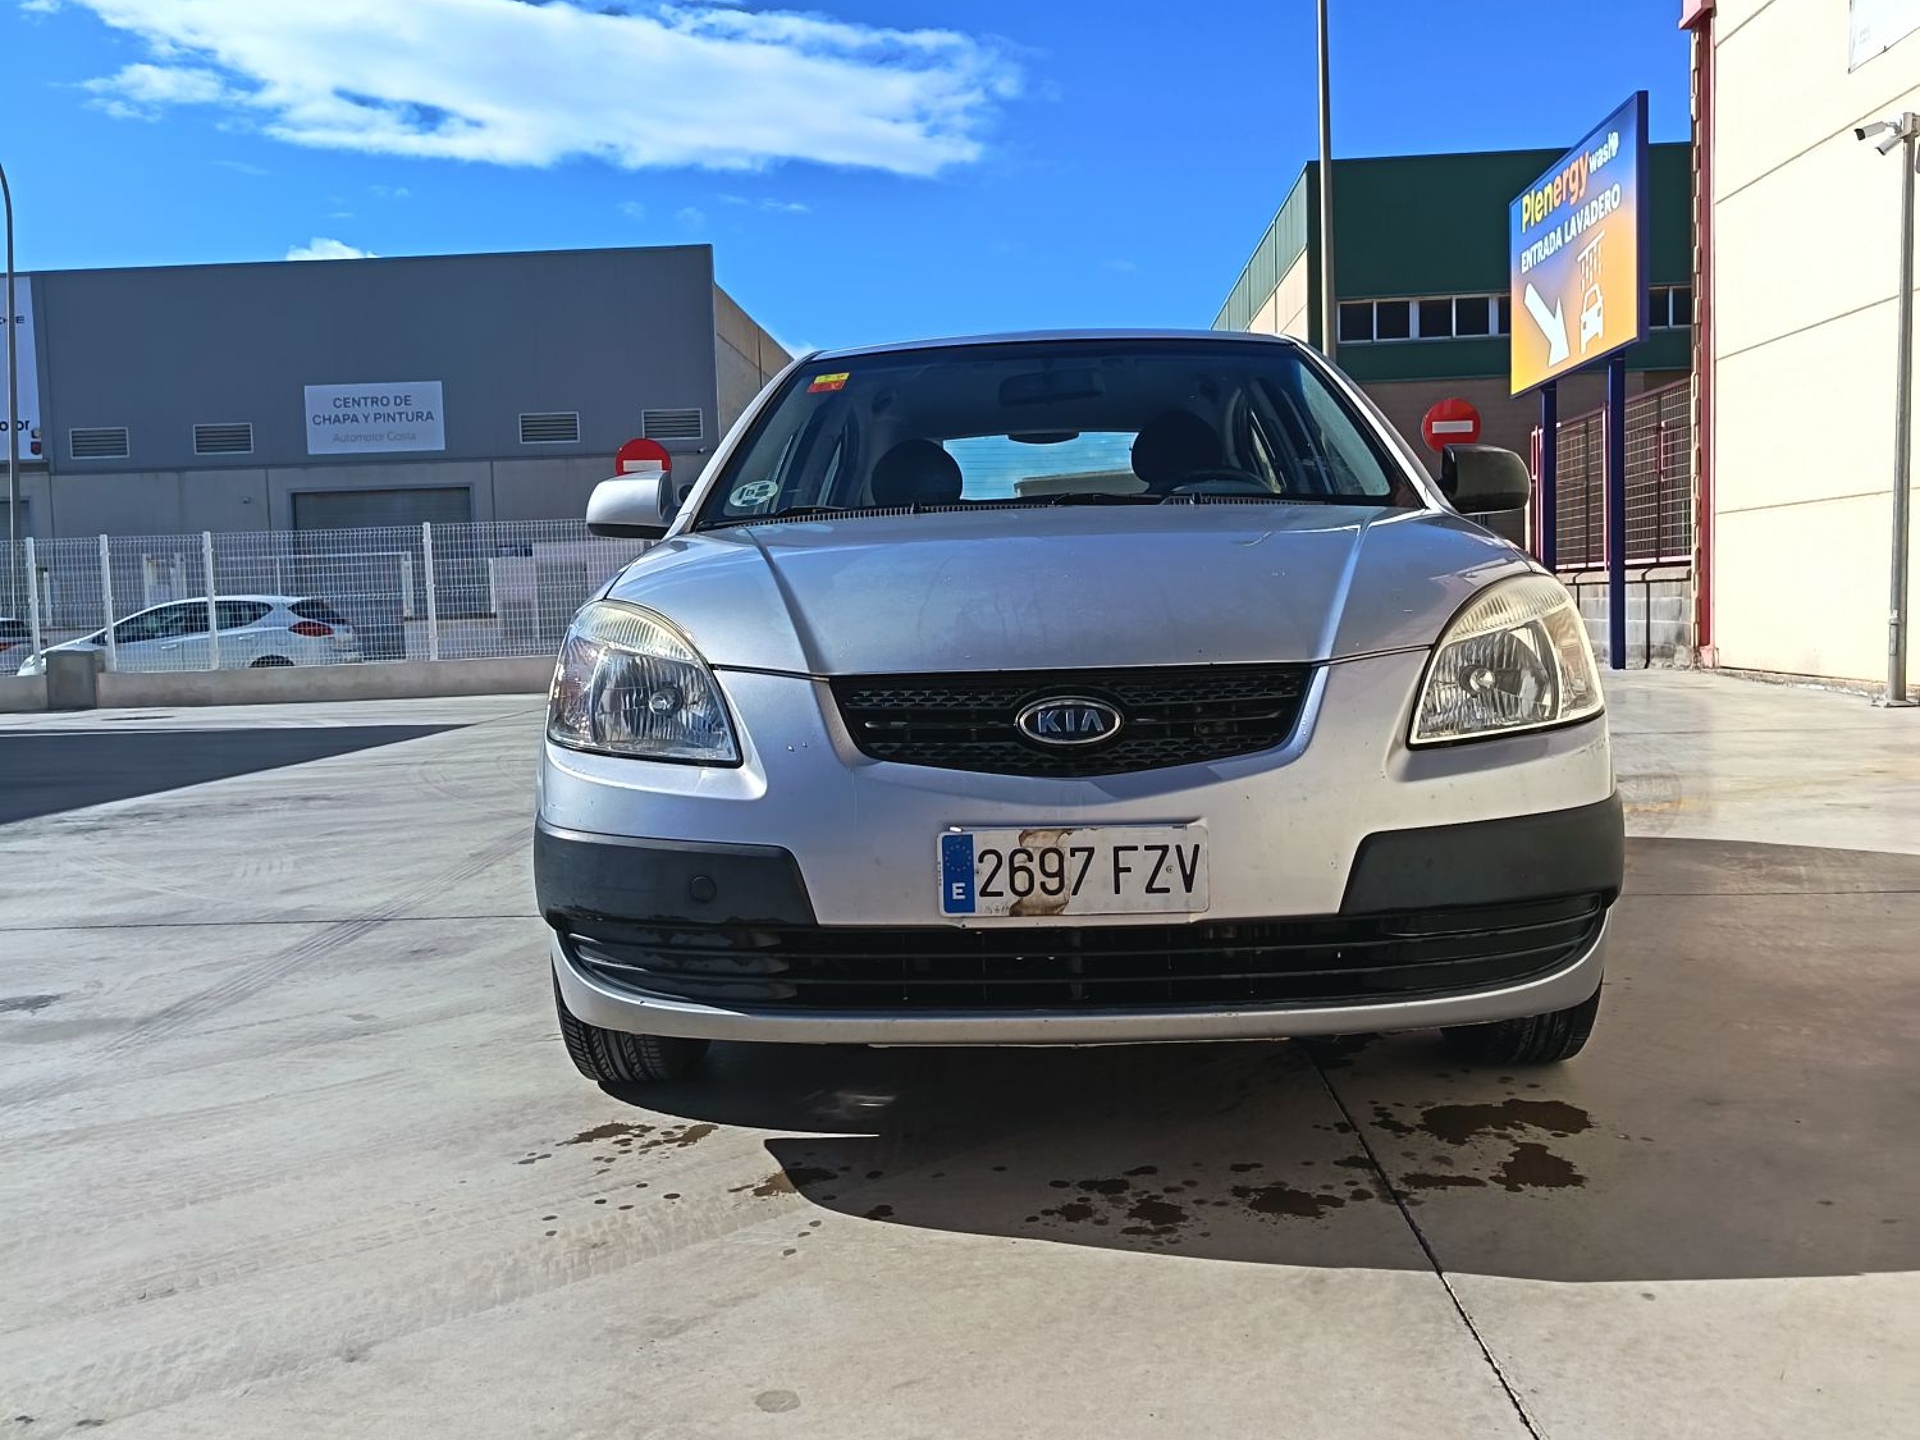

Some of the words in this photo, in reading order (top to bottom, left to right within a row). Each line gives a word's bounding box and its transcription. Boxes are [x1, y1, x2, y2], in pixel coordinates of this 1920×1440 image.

[1521, 151, 1590, 234] Plenergy
[1521, 226, 1563, 274] ENTRADA
[1564, 183, 1621, 243] LAVADERO
[333, 396, 390, 409] CENTRO
[393, 394, 412, 407] DE
[312, 413, 360, 426] CHAPA
[361, 412, 371, 424] Y
[373, 410, 435, 424] PINTURA
[333, 432, 384, 443] Automotor
[387, 431, 416, 441] Costa
[1037, 709, 1105, 733] KIA
[977, 847, 1096, 899] 2697
[1112, 843, 1201, 895] FZV
[952, 882, 966, 900] E
